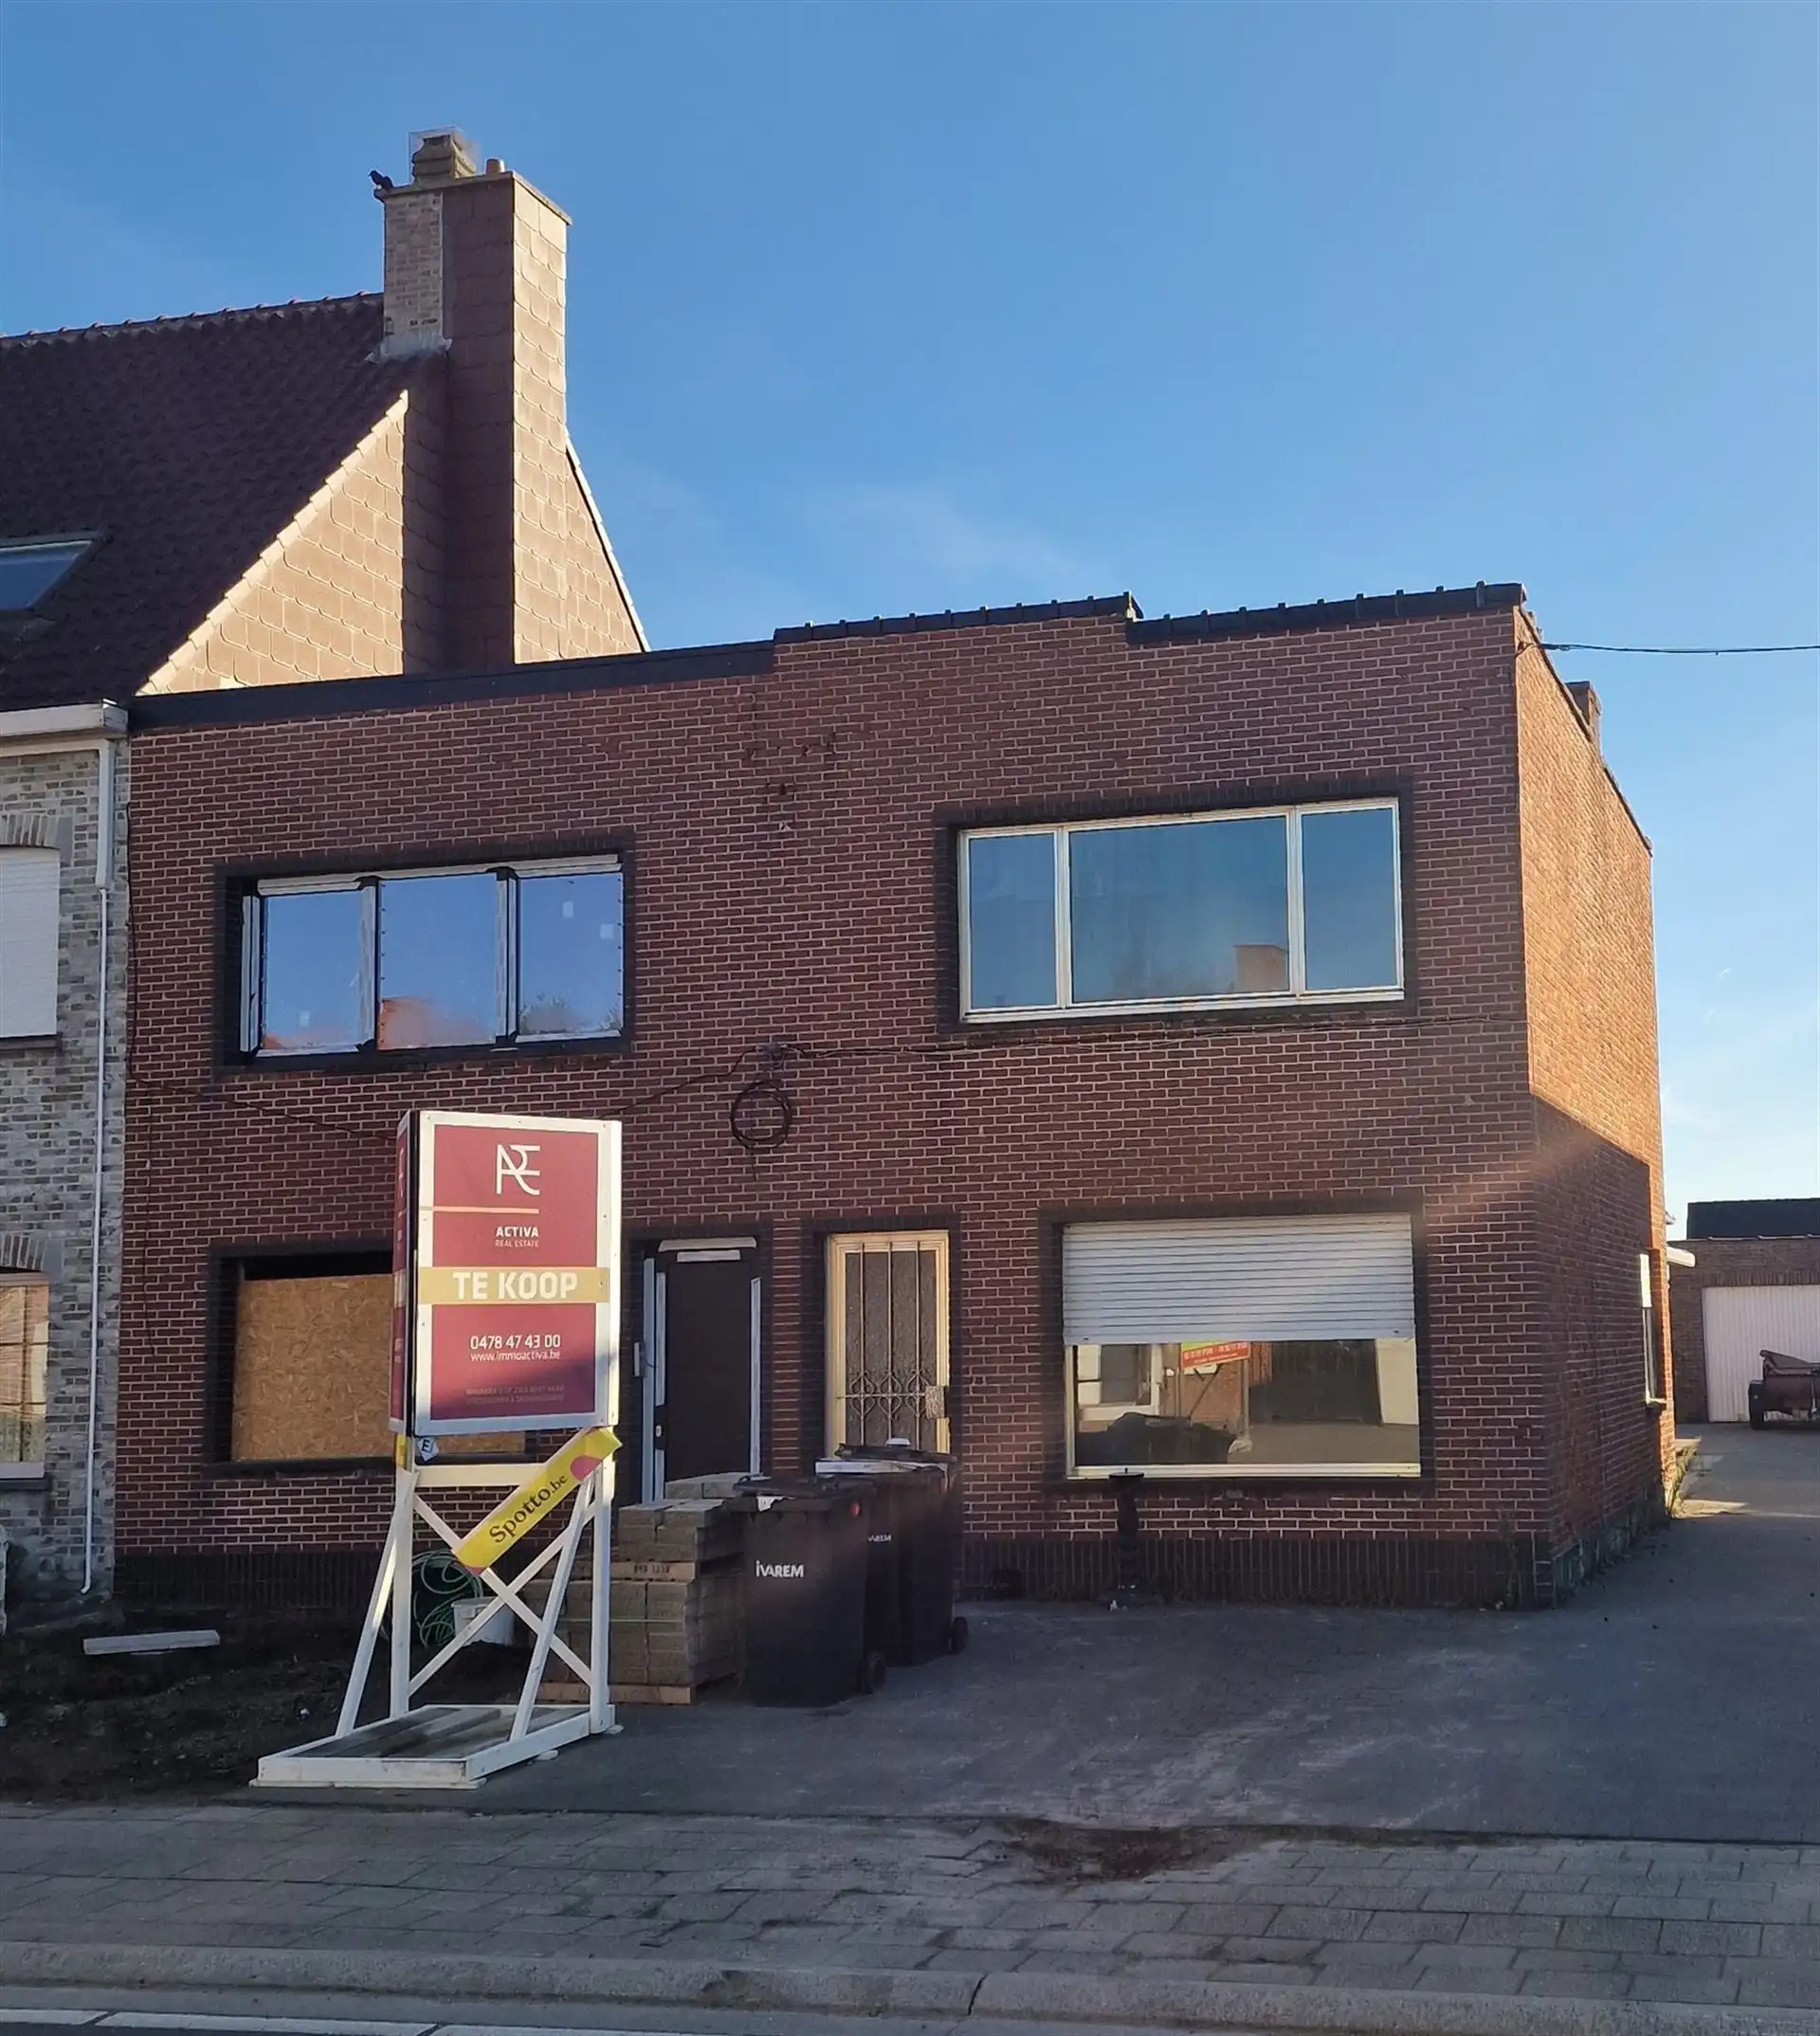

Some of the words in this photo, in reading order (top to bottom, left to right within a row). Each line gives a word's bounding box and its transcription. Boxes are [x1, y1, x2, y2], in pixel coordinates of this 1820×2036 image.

[496, 1226, 539, 1239] ACTIVA
[495, 1239, 514, 1247] REAL
[515, 1239, 539, 1247] ESTATE
[452, 1271, 488, 1300] TE
[498, 1271, 578, 1300] KOOP
[470, 1335, 502, 1350] 0478
[505, 1335, 522, 1349] 47
[524, 1335, 541, 1349] 43
[544, 1334, 561, 1348] 00
[470, 1348, 561, 1362] www.immoactiva.be
[488, 1475, 569, 1544] Spotto.be
